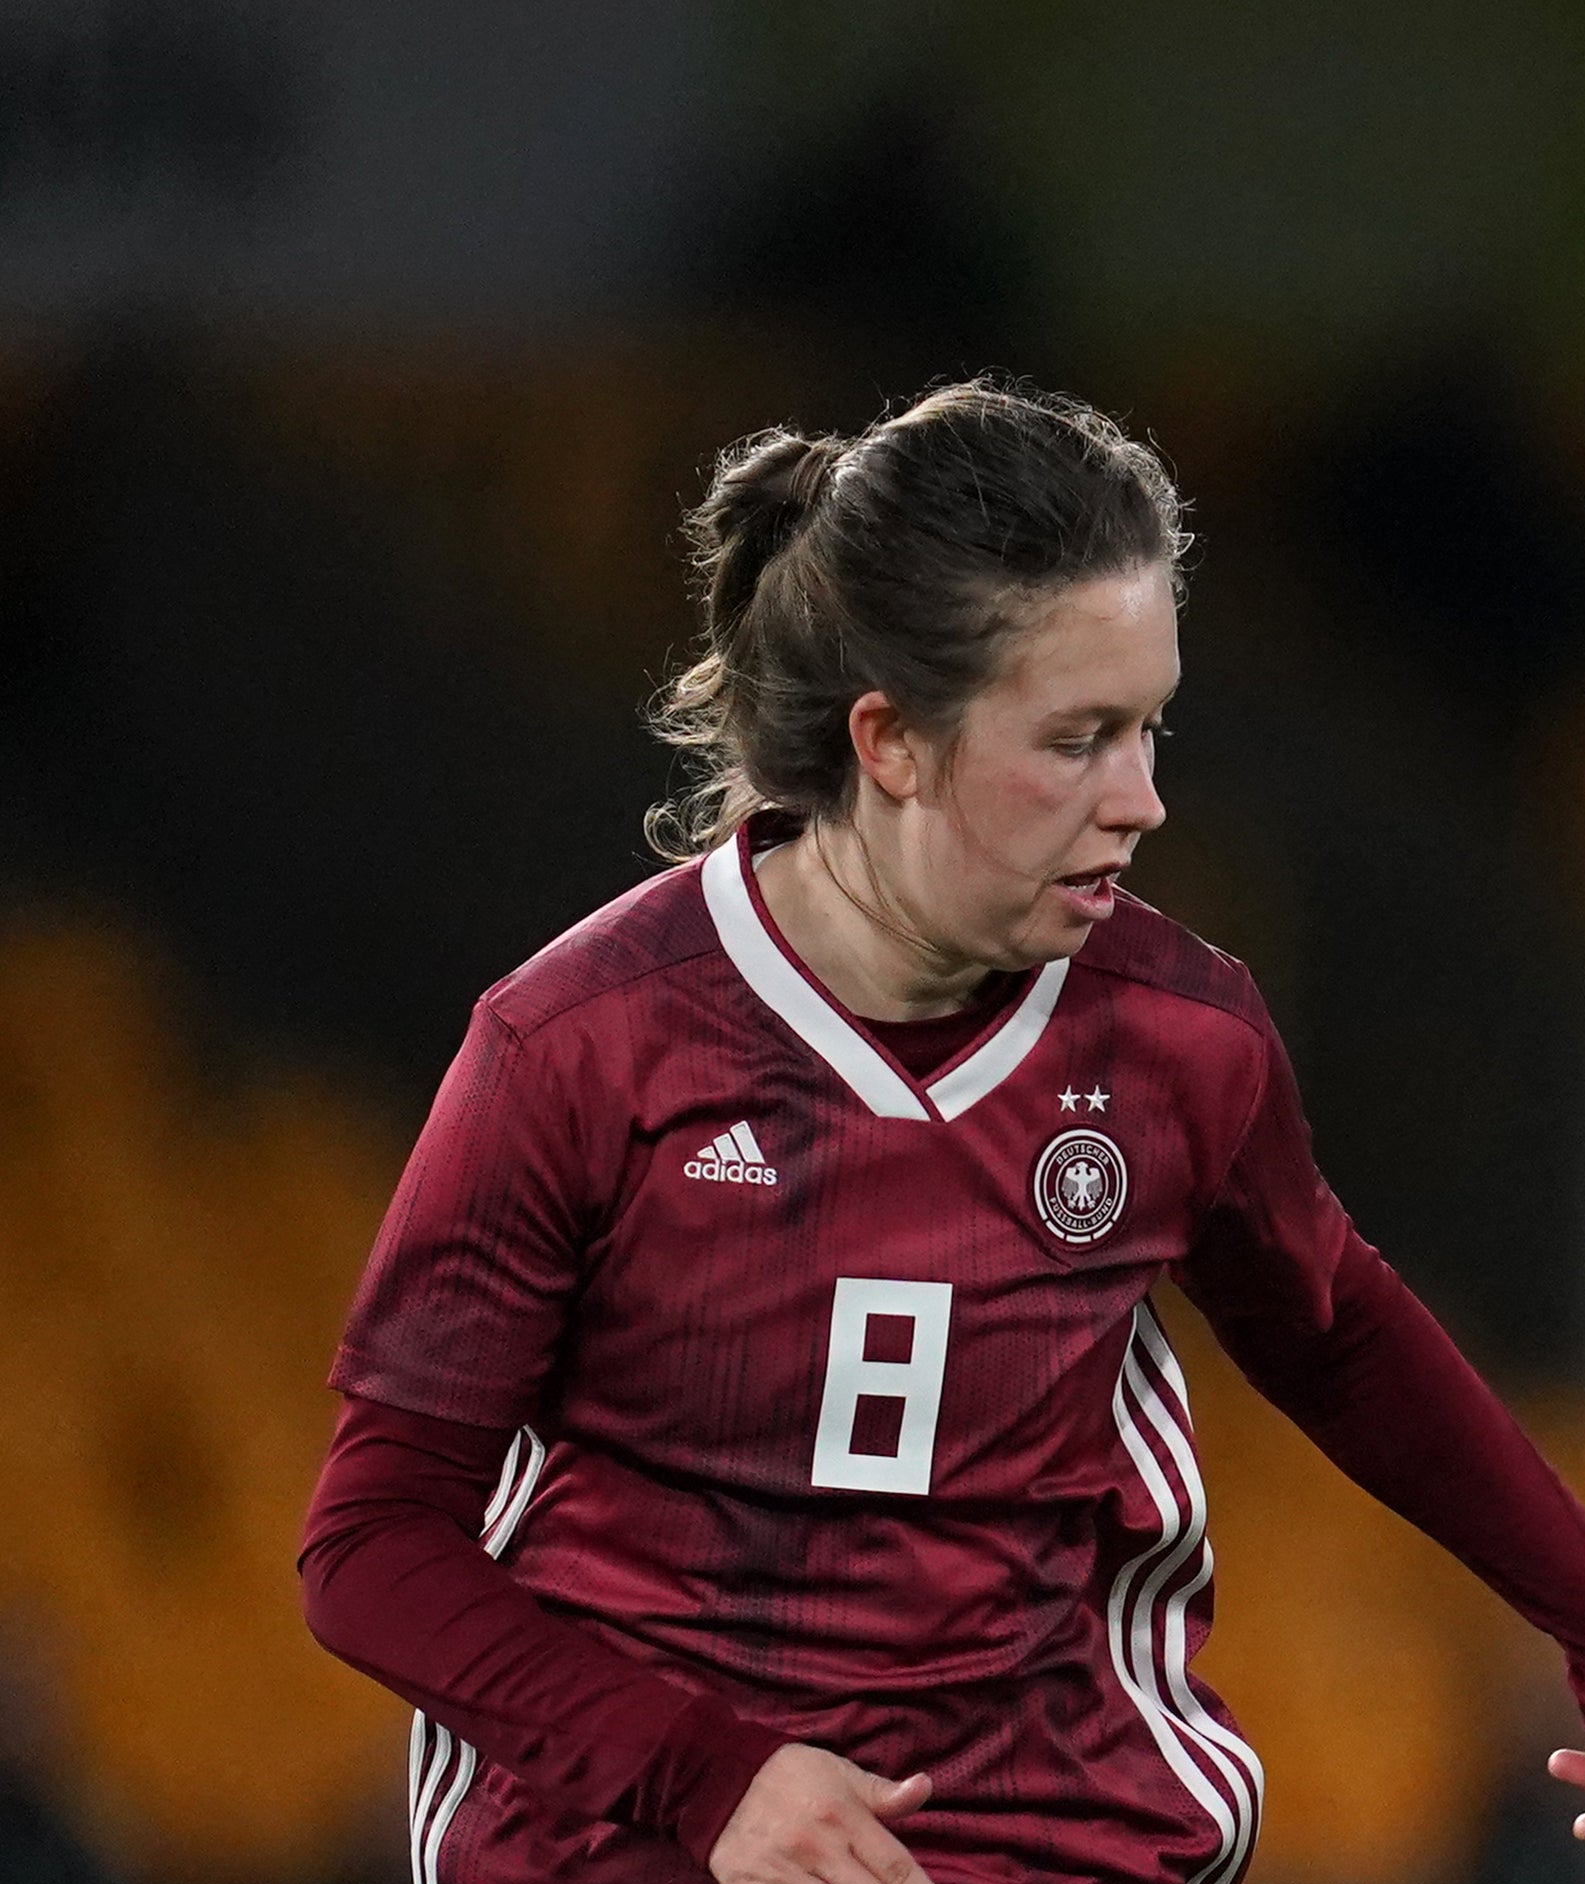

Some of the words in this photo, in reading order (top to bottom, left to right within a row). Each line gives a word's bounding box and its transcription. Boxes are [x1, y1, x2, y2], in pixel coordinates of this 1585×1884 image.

[1055, 1143, 1110, 1166] DEUTSCHER
[683, 1158, 778, 1186] adidas
[811, 1277, 953, 1496] 8
